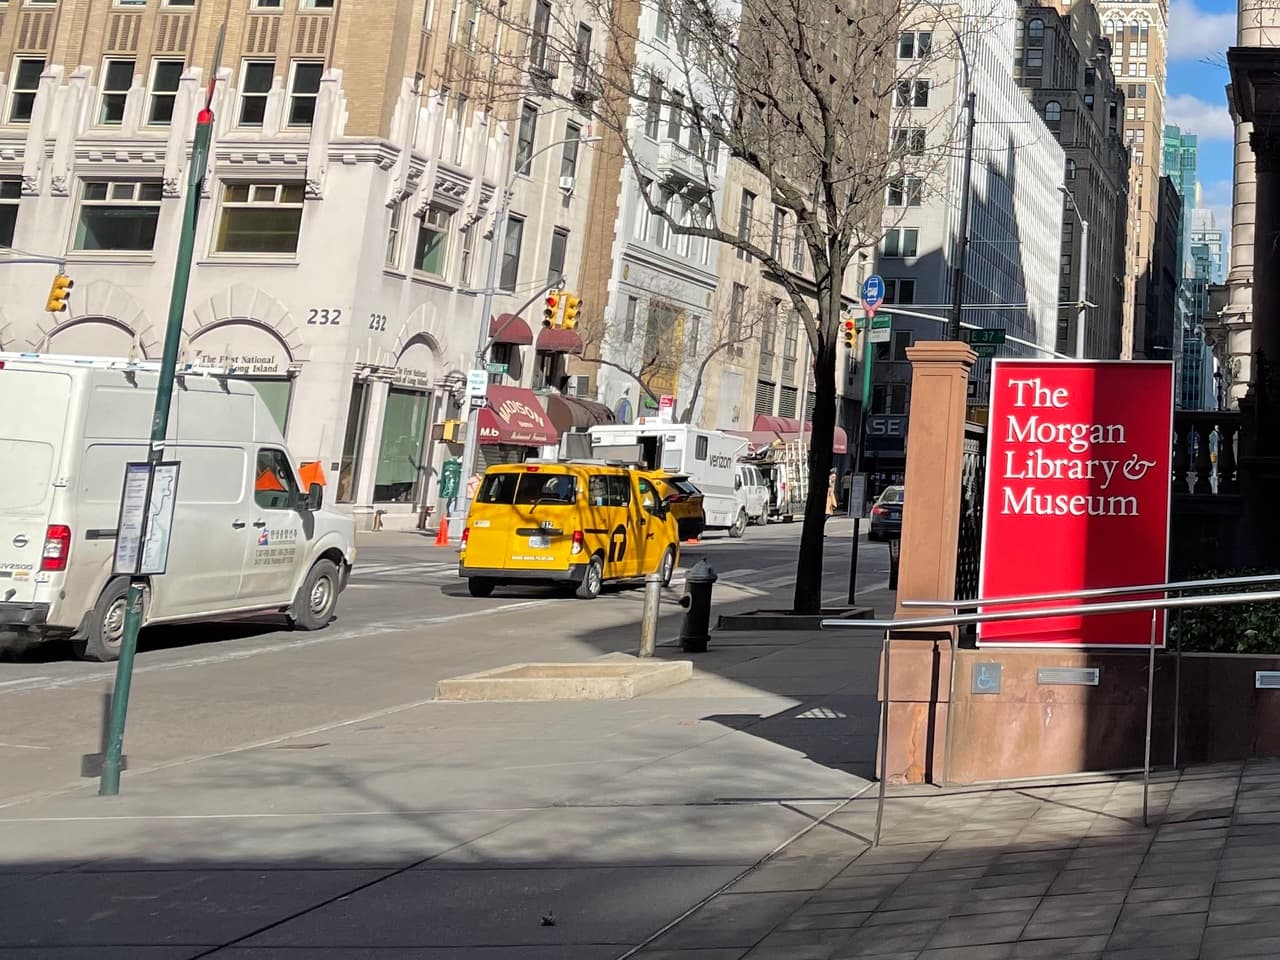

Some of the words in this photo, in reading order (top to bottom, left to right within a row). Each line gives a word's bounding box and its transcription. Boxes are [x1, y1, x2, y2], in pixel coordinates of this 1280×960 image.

[307, 309, 341, 325] 232
[369, 313, 387, 331] 232
[983, 331, 994, 341] 37
[202, 355, 217, 363] The
[241, 355, 275, 364] National
[253, 364, 278, 373] Island
[1008, 378, 1069, 408] The
[499, 400, 545, 427] MADISON
[1005, 416, 1127, 452] Morgan
[709, 452, 732, 469] verizon
[1003, 450, 1121, 489] Library
[1122, 454, 1157, 480] &
[1001, 487, 1140, 517] Museum
